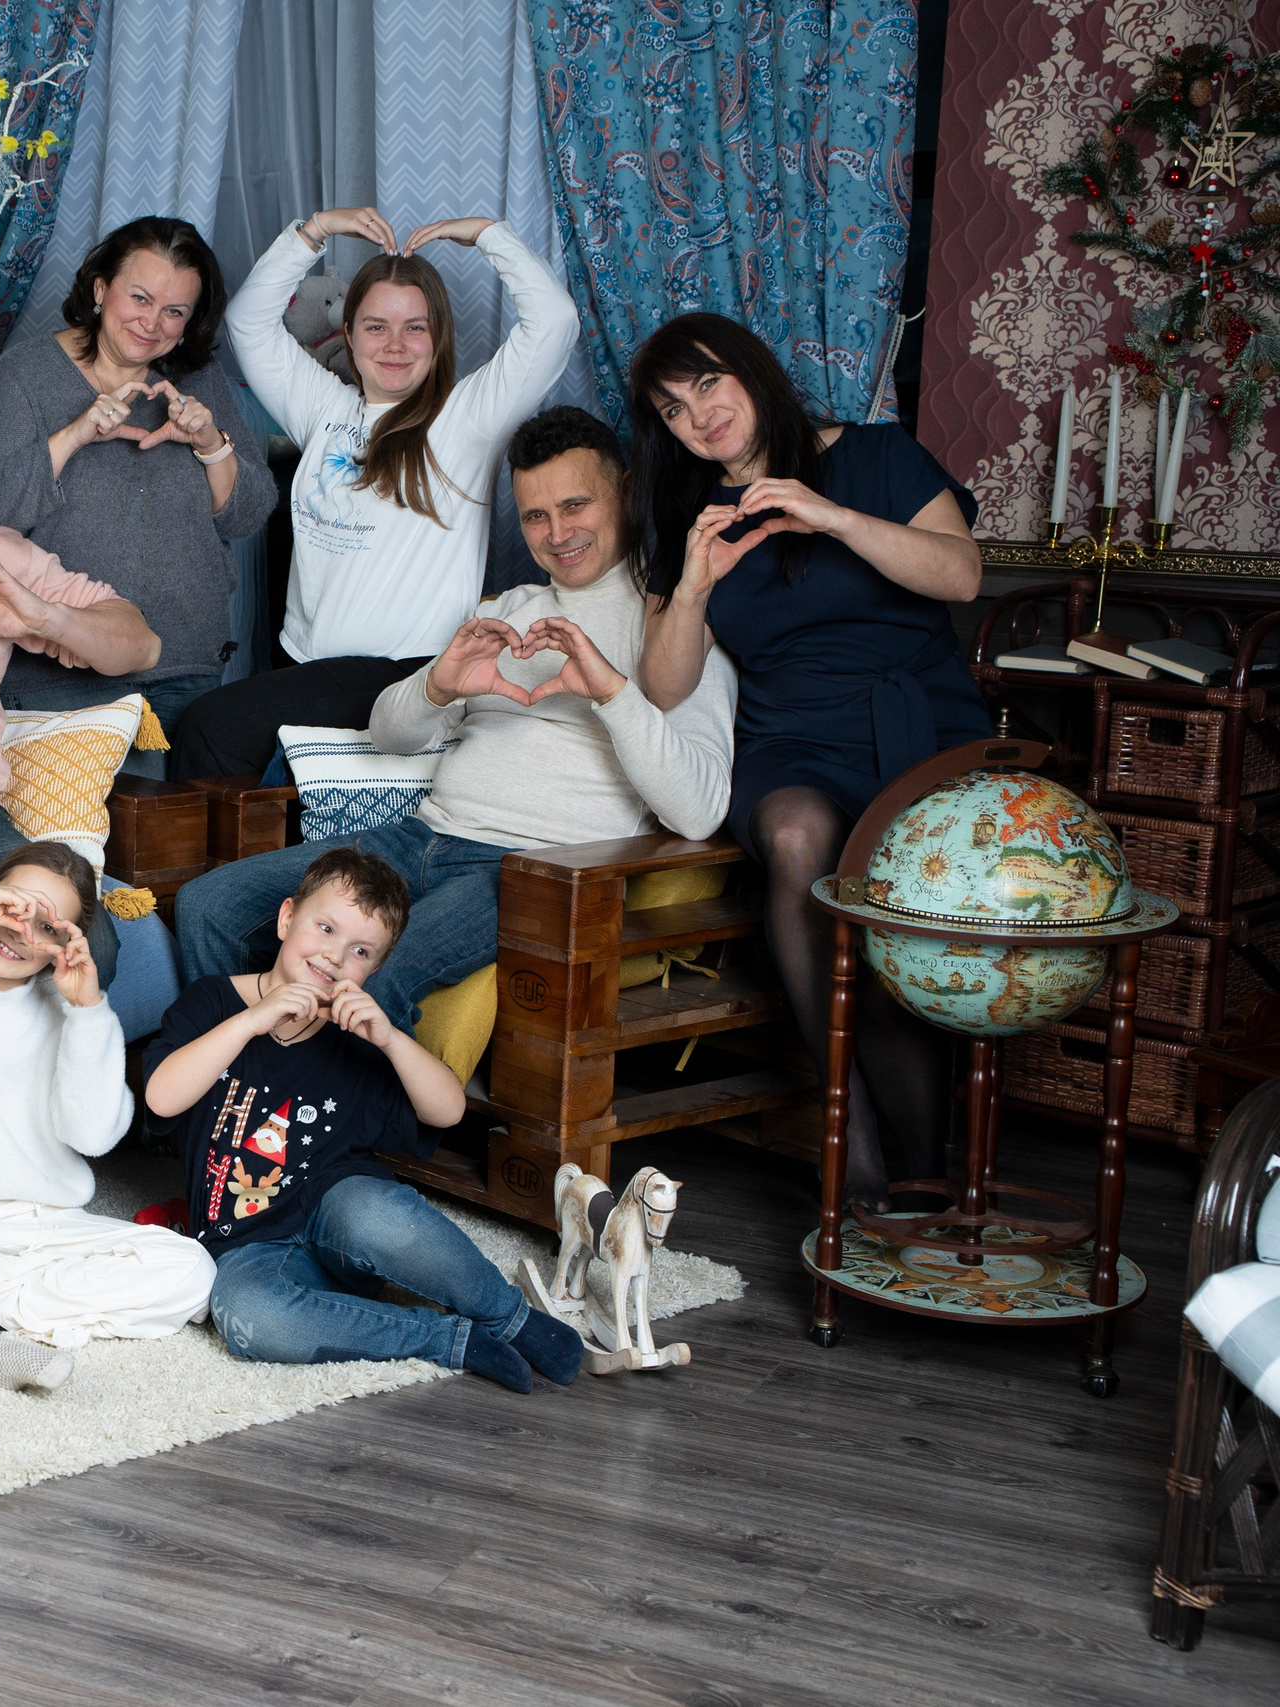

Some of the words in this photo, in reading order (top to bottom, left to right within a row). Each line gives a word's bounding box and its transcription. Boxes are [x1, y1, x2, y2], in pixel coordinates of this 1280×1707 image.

[331, 518, 352, 531] dreams
[352, 521, 376, 535] happen
[514, 978, 547, 1003] EUR
[507, 1163, 540, 1190] EUR
